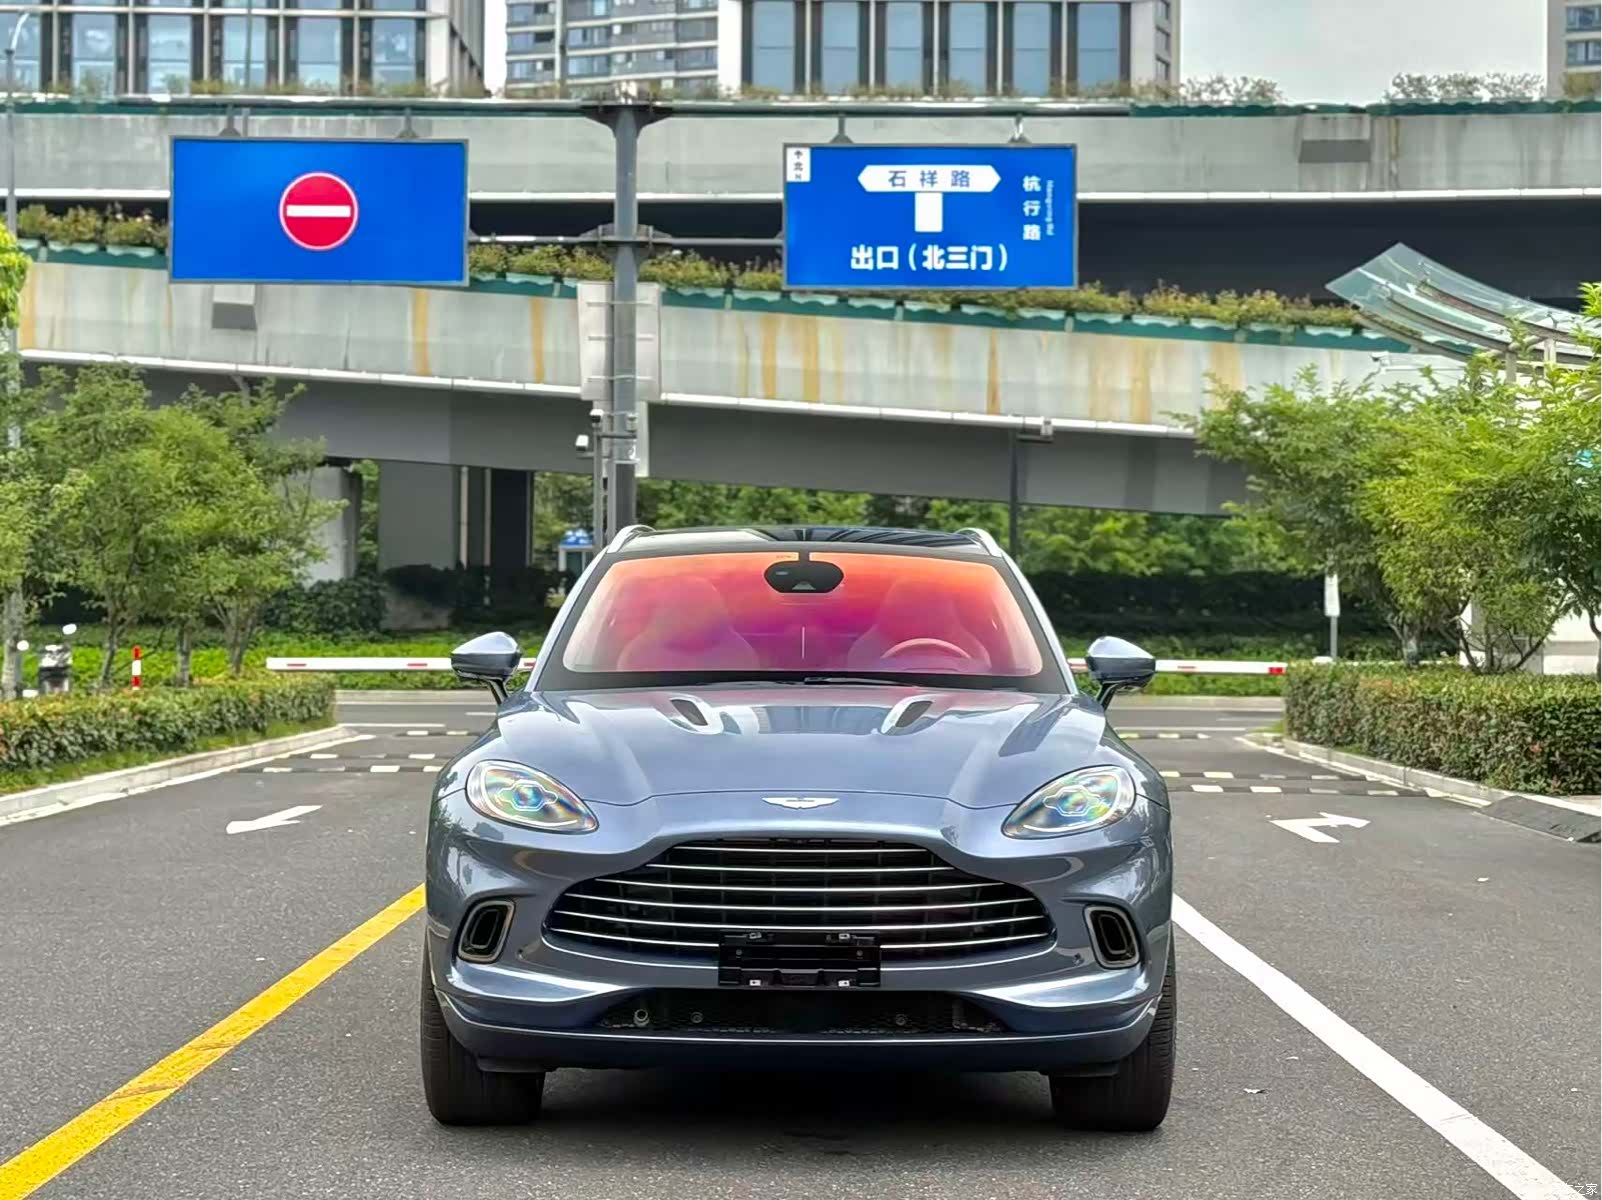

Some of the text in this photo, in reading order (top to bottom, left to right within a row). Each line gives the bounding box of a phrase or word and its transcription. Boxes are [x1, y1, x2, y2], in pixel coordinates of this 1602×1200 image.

[888, 170, 970, 188] 石祥路
[1022, 176, 1041, 240] 杭行路
[850, 243, 1008, 272] 出口（北三门）
